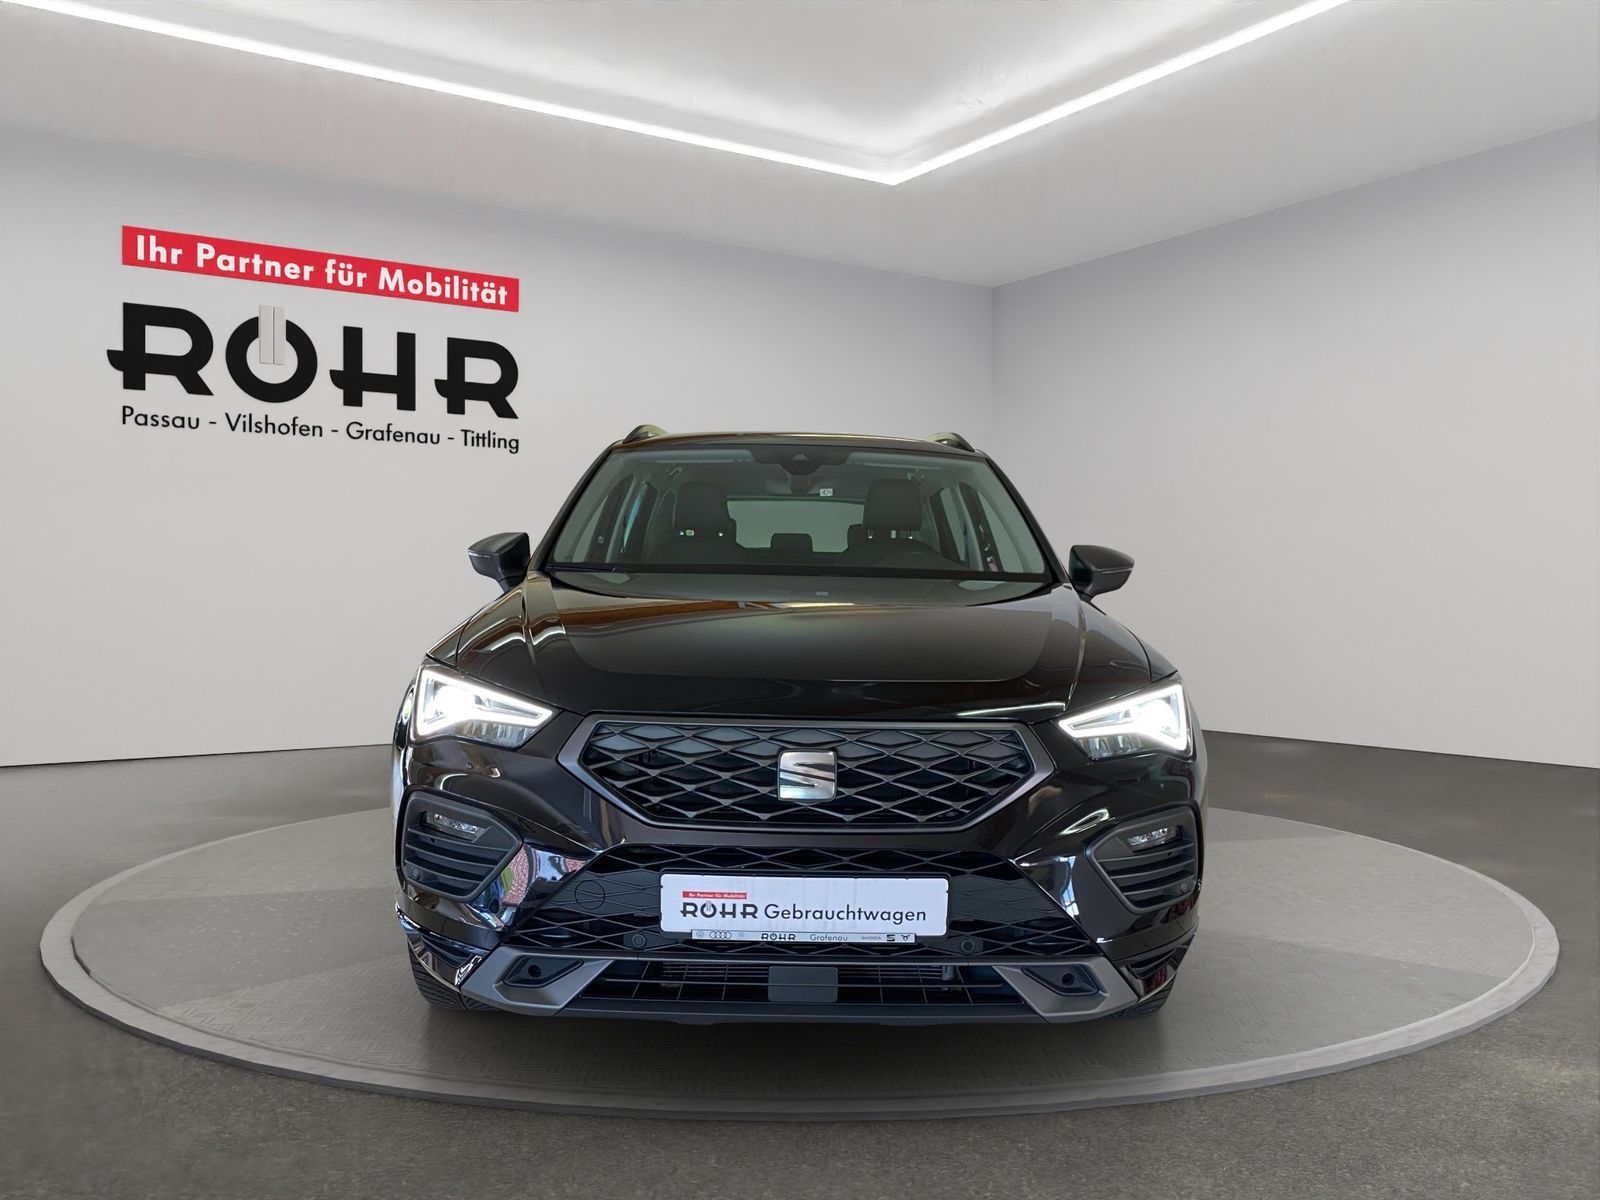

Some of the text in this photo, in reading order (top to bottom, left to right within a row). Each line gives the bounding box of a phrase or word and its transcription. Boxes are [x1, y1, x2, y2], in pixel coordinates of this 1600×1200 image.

[137, 235, 508, 305] Ihr Partner für Mobilität
[106, 302, 519, 420] RÖHR
[122, 406, 200, 430] Passau
[225, 412, 323, 438] Vilshofen
[345, 421, 441, 445] Grafenau
[461, 429, 520, 455] Tittling
[680, 901, 927, 925] RÖHR Gebrauchtwagen
[809, 933, 848, 941] Grafenau
